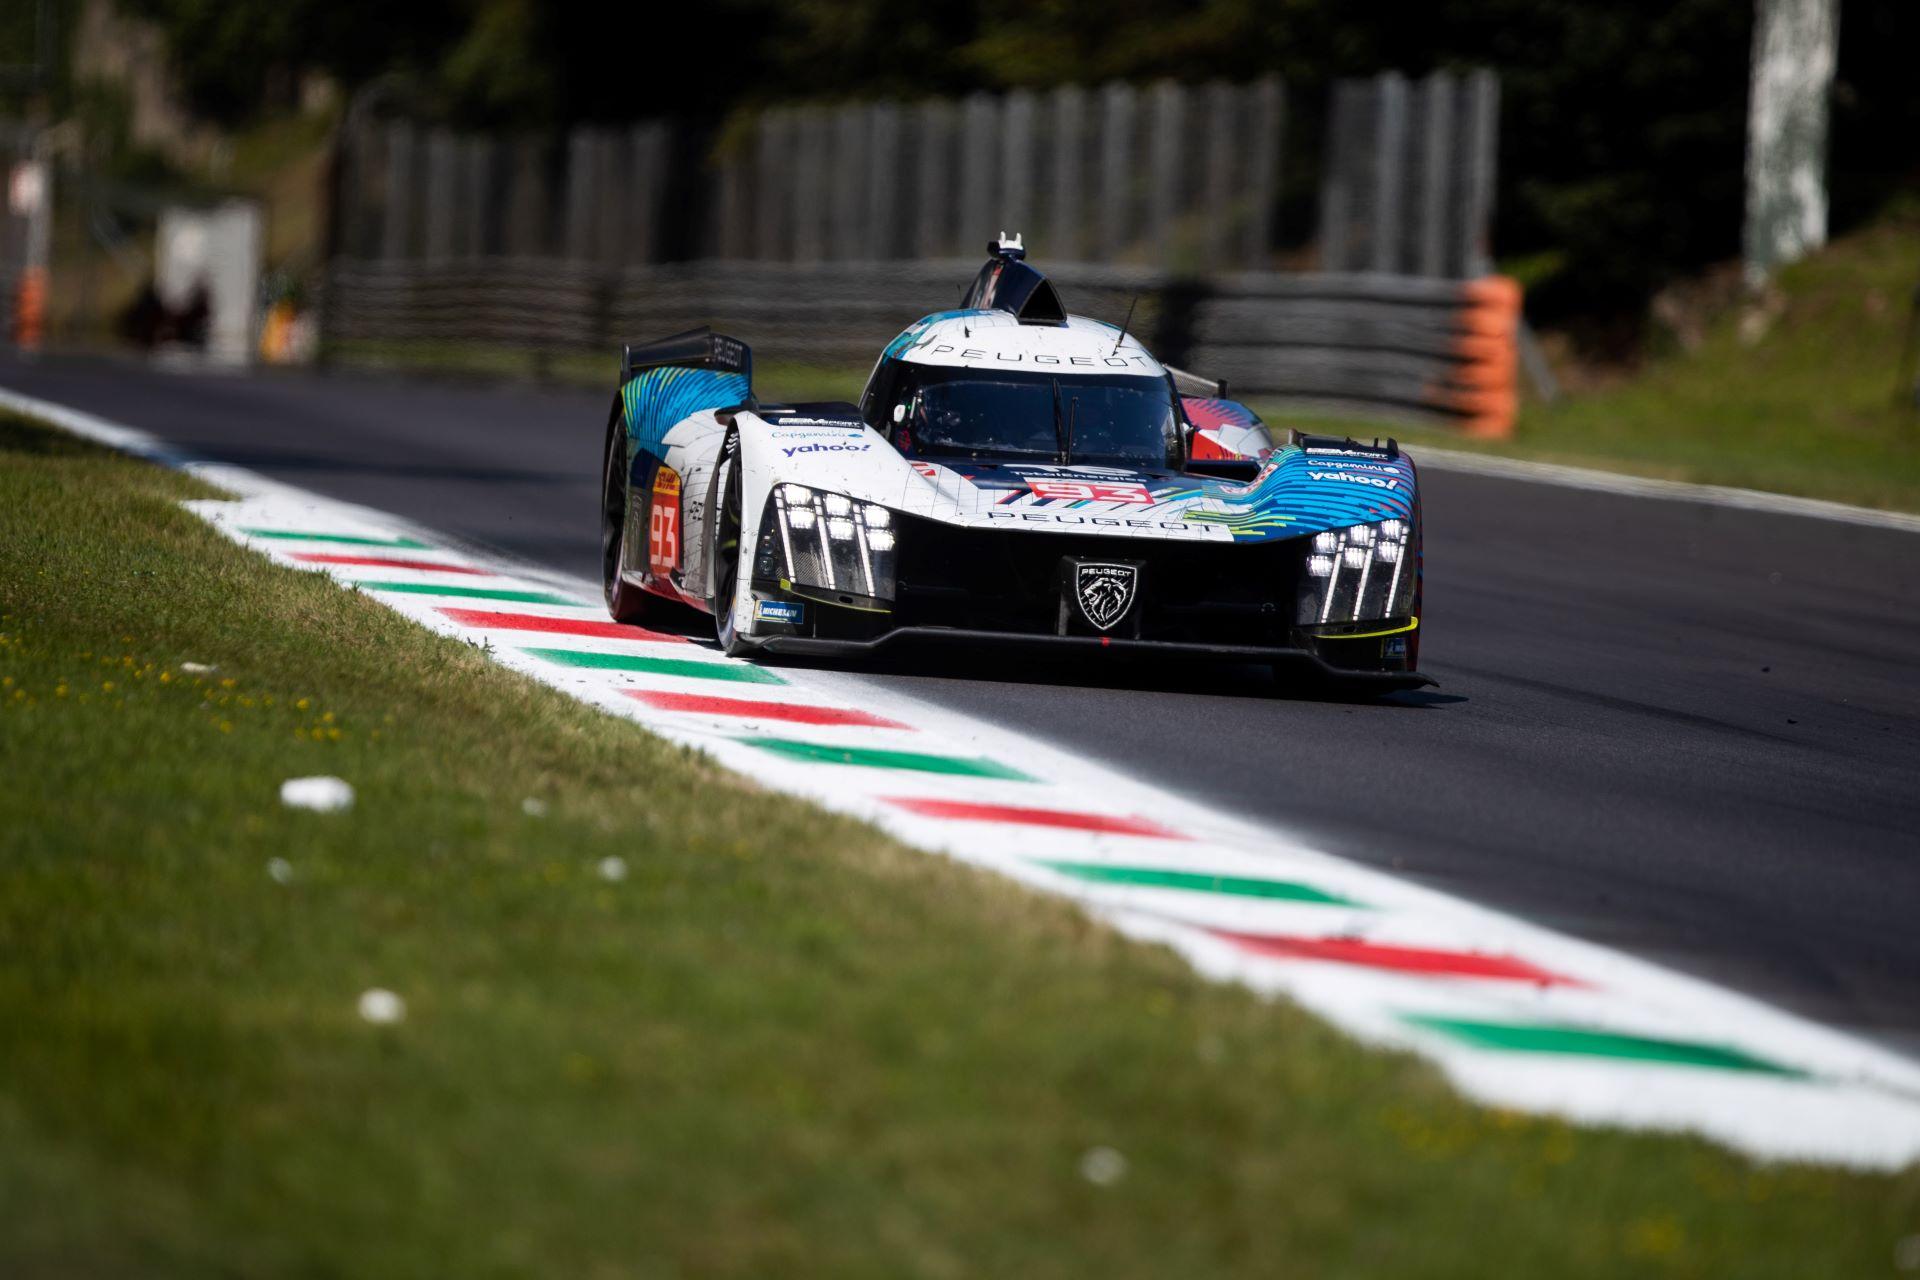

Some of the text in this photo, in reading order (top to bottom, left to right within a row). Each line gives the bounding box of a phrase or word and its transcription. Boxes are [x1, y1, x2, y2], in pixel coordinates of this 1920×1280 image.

[931, 344, 1147, 368] PEUGEOT
[781, 443, 871, 457] yahoo!
[1307, 459, 1383, 471] Capgemini
[1307, 471, 1398, 490] yahoo!
[1033, 483, 1148, 503] 93
[987, 511, 1220, 533] PEUGEOT
[650, 504, 676, 567] 93
[1081, 568, 1132, 576] PEUGEOT
